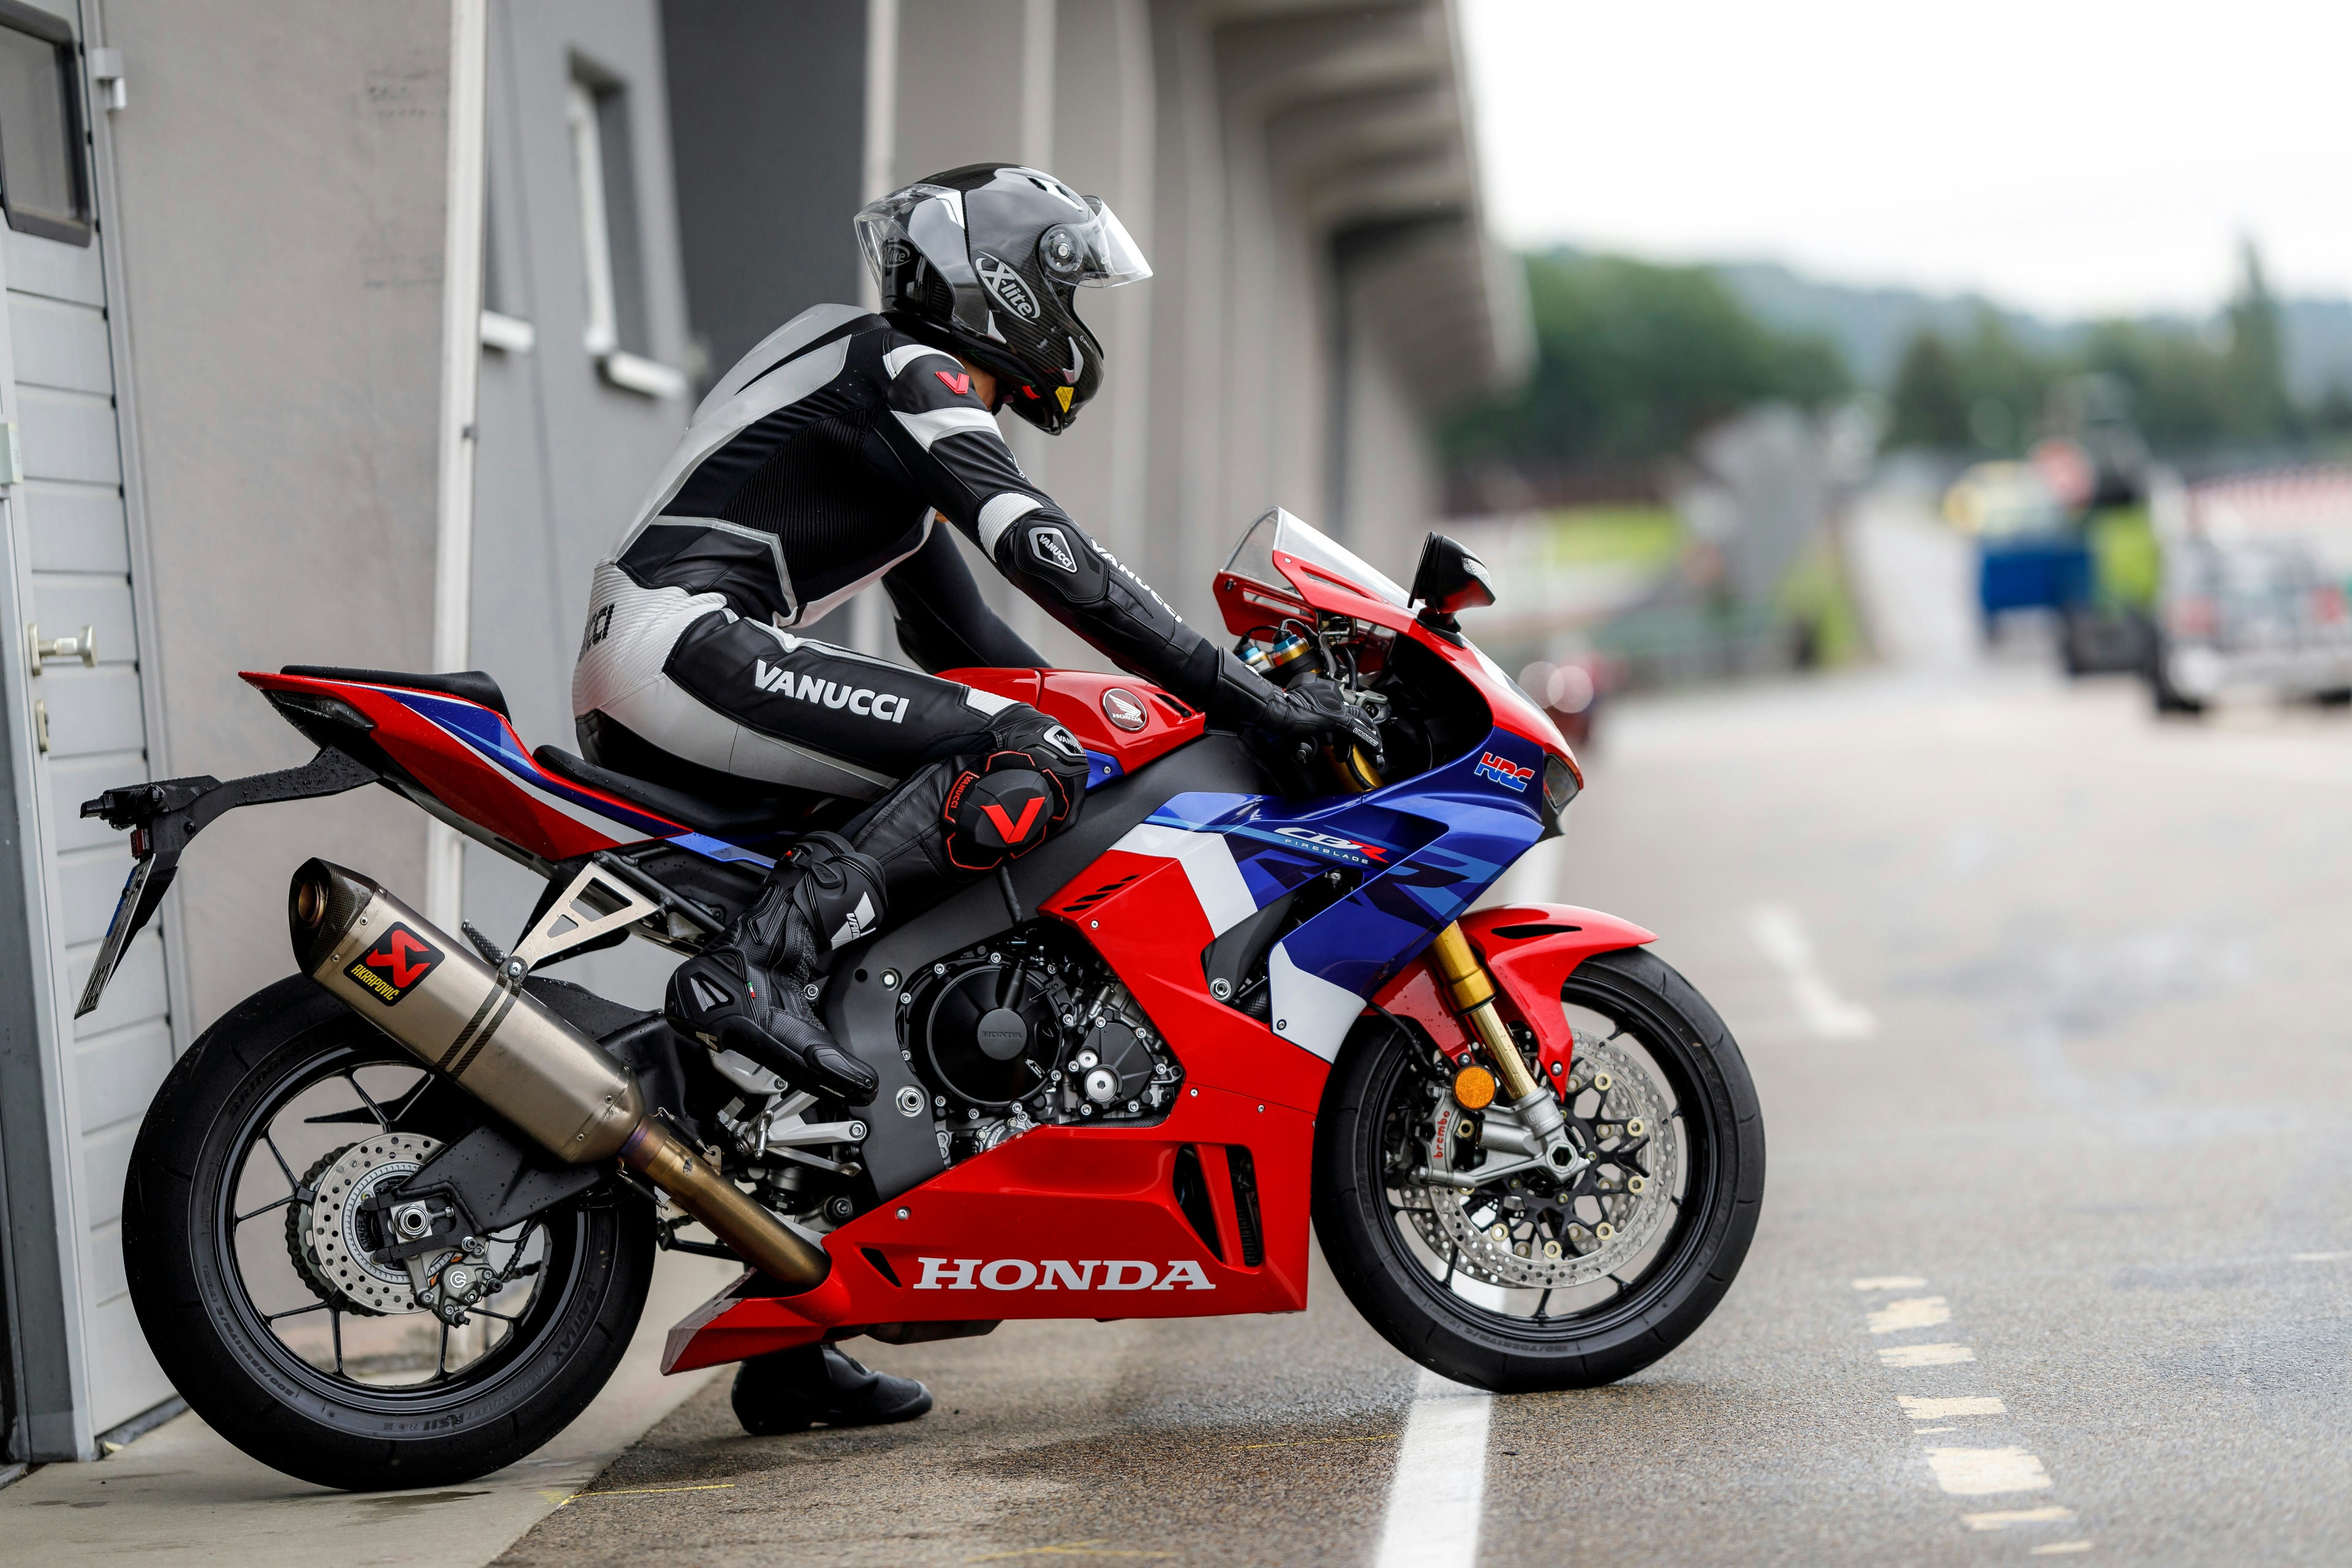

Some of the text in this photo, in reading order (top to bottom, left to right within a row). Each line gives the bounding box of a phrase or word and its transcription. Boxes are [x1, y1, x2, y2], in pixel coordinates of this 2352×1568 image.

[979, 260, 1033, 316] X-lite
[1039, 535, 1072, 568] VANUCCI
[755, 658, 911, 724] VANUCCI
[1112, 712, 1144, 723] HONDA
[1352, 727, 1379, 747] VANUCCI
[1474, 752, 1536, 793] HRC
[950, 775, 974, 809] VANUCCI
[1274, 827, 1389, 864] CBR
[1284, 838, 1369, 865] FIREBLADE
[1433, 1110, 1450, 1159] brembo
[913, 1257, 1216, 1291] HONDA
